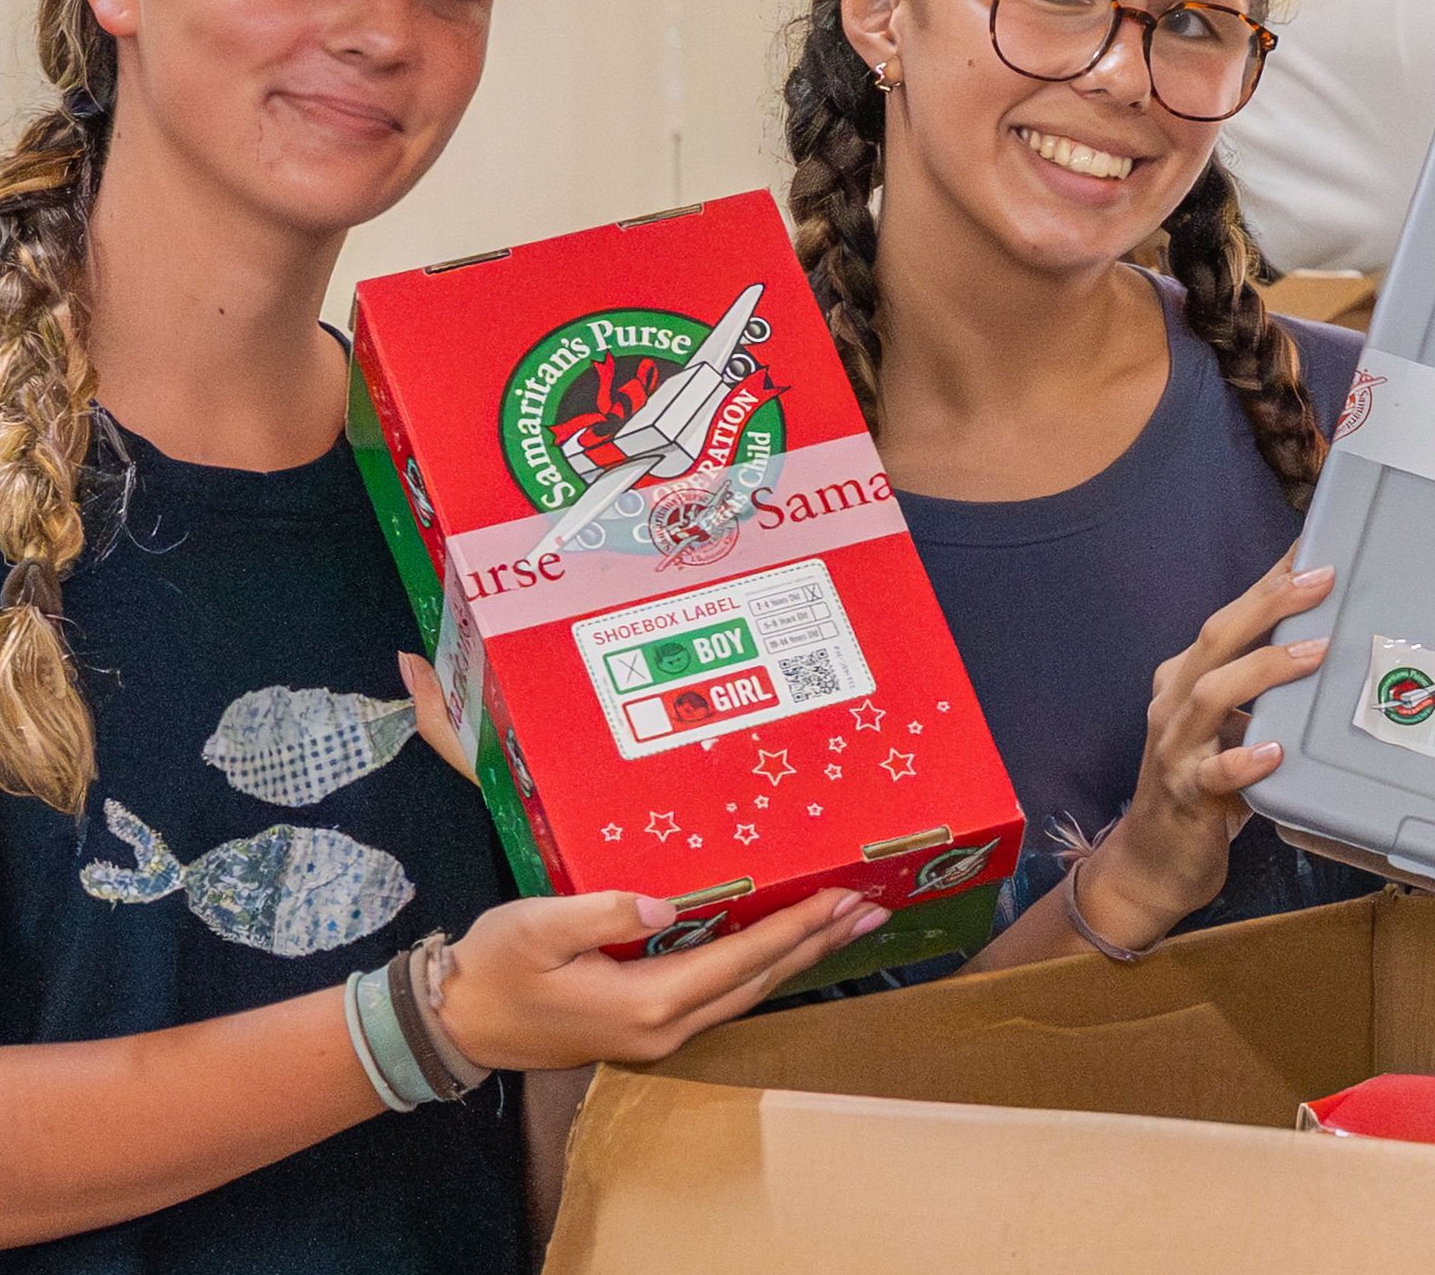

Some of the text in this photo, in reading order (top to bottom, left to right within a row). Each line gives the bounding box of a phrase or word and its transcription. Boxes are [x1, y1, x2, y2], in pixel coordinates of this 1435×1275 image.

[516, 319, 692, 509] Samaritan's Purse
[739, 430, 771, 489] Child
[593, 596, 741, 646] SHOEBOX LABEL
[693, 627, 745, 665] BOY
[710, 675, 773, 712] GIRL
